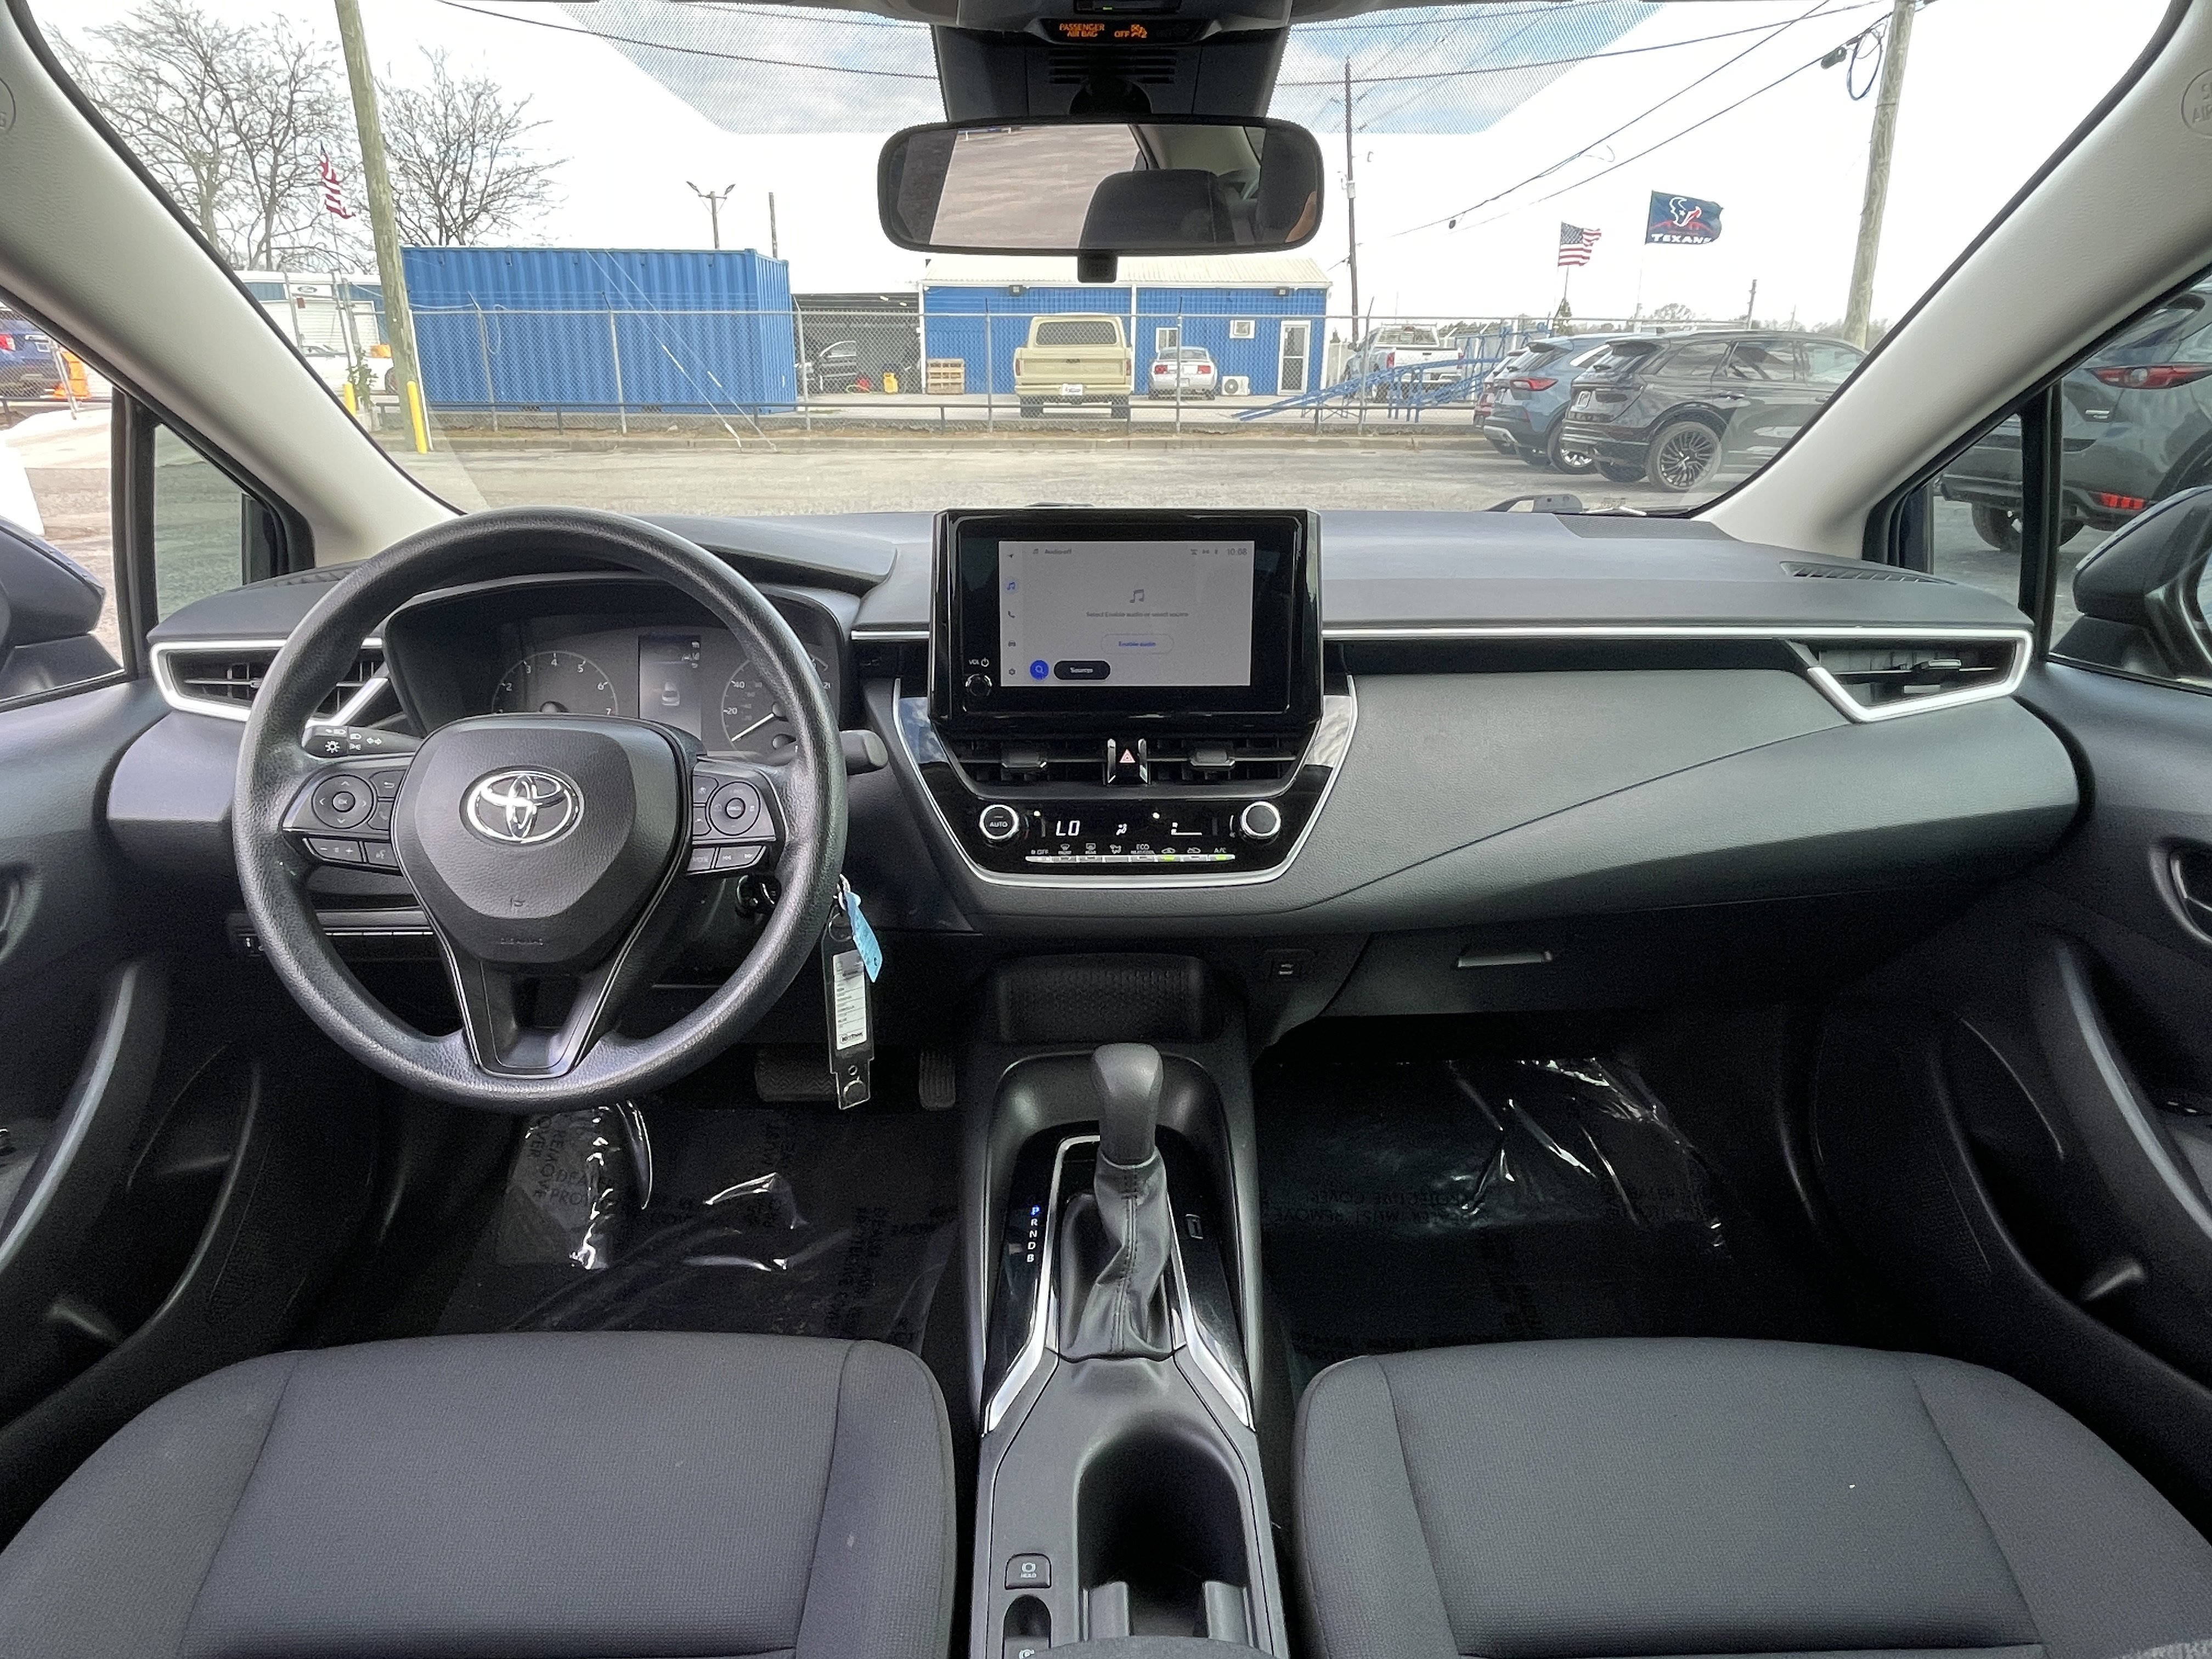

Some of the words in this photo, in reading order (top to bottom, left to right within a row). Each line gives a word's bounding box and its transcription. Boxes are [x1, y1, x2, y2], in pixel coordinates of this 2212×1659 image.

[1031, 1206, 1040, 1216] P
[1031, 1218, 1038, 1226] R
[1029, 1230, 1037, 1239] N
[1028, 1242, 1036, 1250] D
[1027, 1254, 1035, 1262] B
